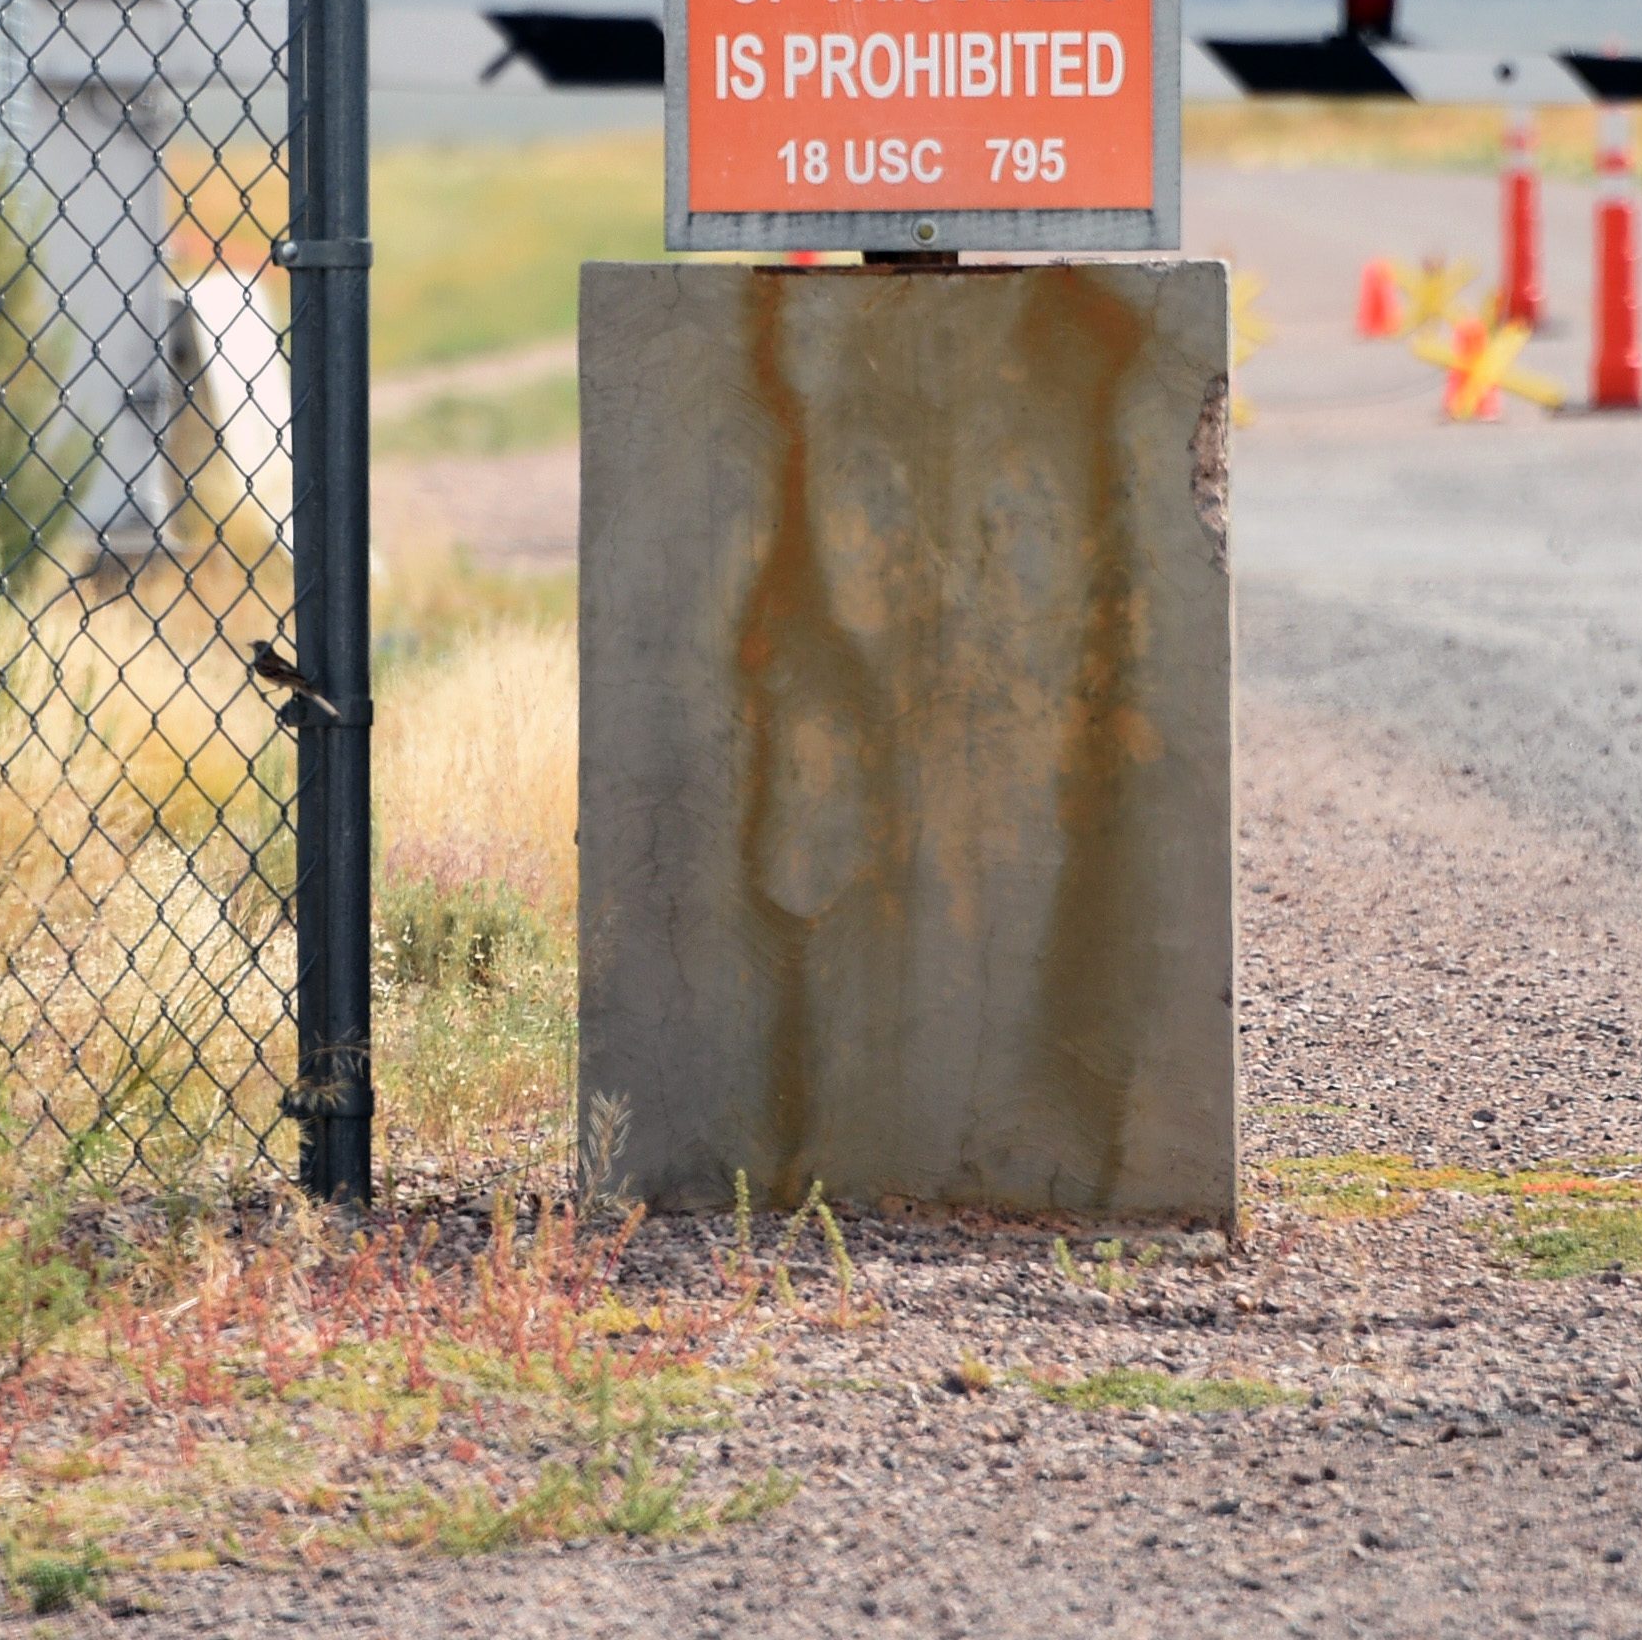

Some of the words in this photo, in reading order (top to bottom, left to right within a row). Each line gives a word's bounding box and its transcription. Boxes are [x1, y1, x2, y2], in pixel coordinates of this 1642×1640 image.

[716, 33, 766, 100] IS
[783, 31, 1126, 99] PROHIBITED
[777, 139, 830, 184] 18
[844, 139, 944, 184] USC
[985, 138, 1068, 183] 795
